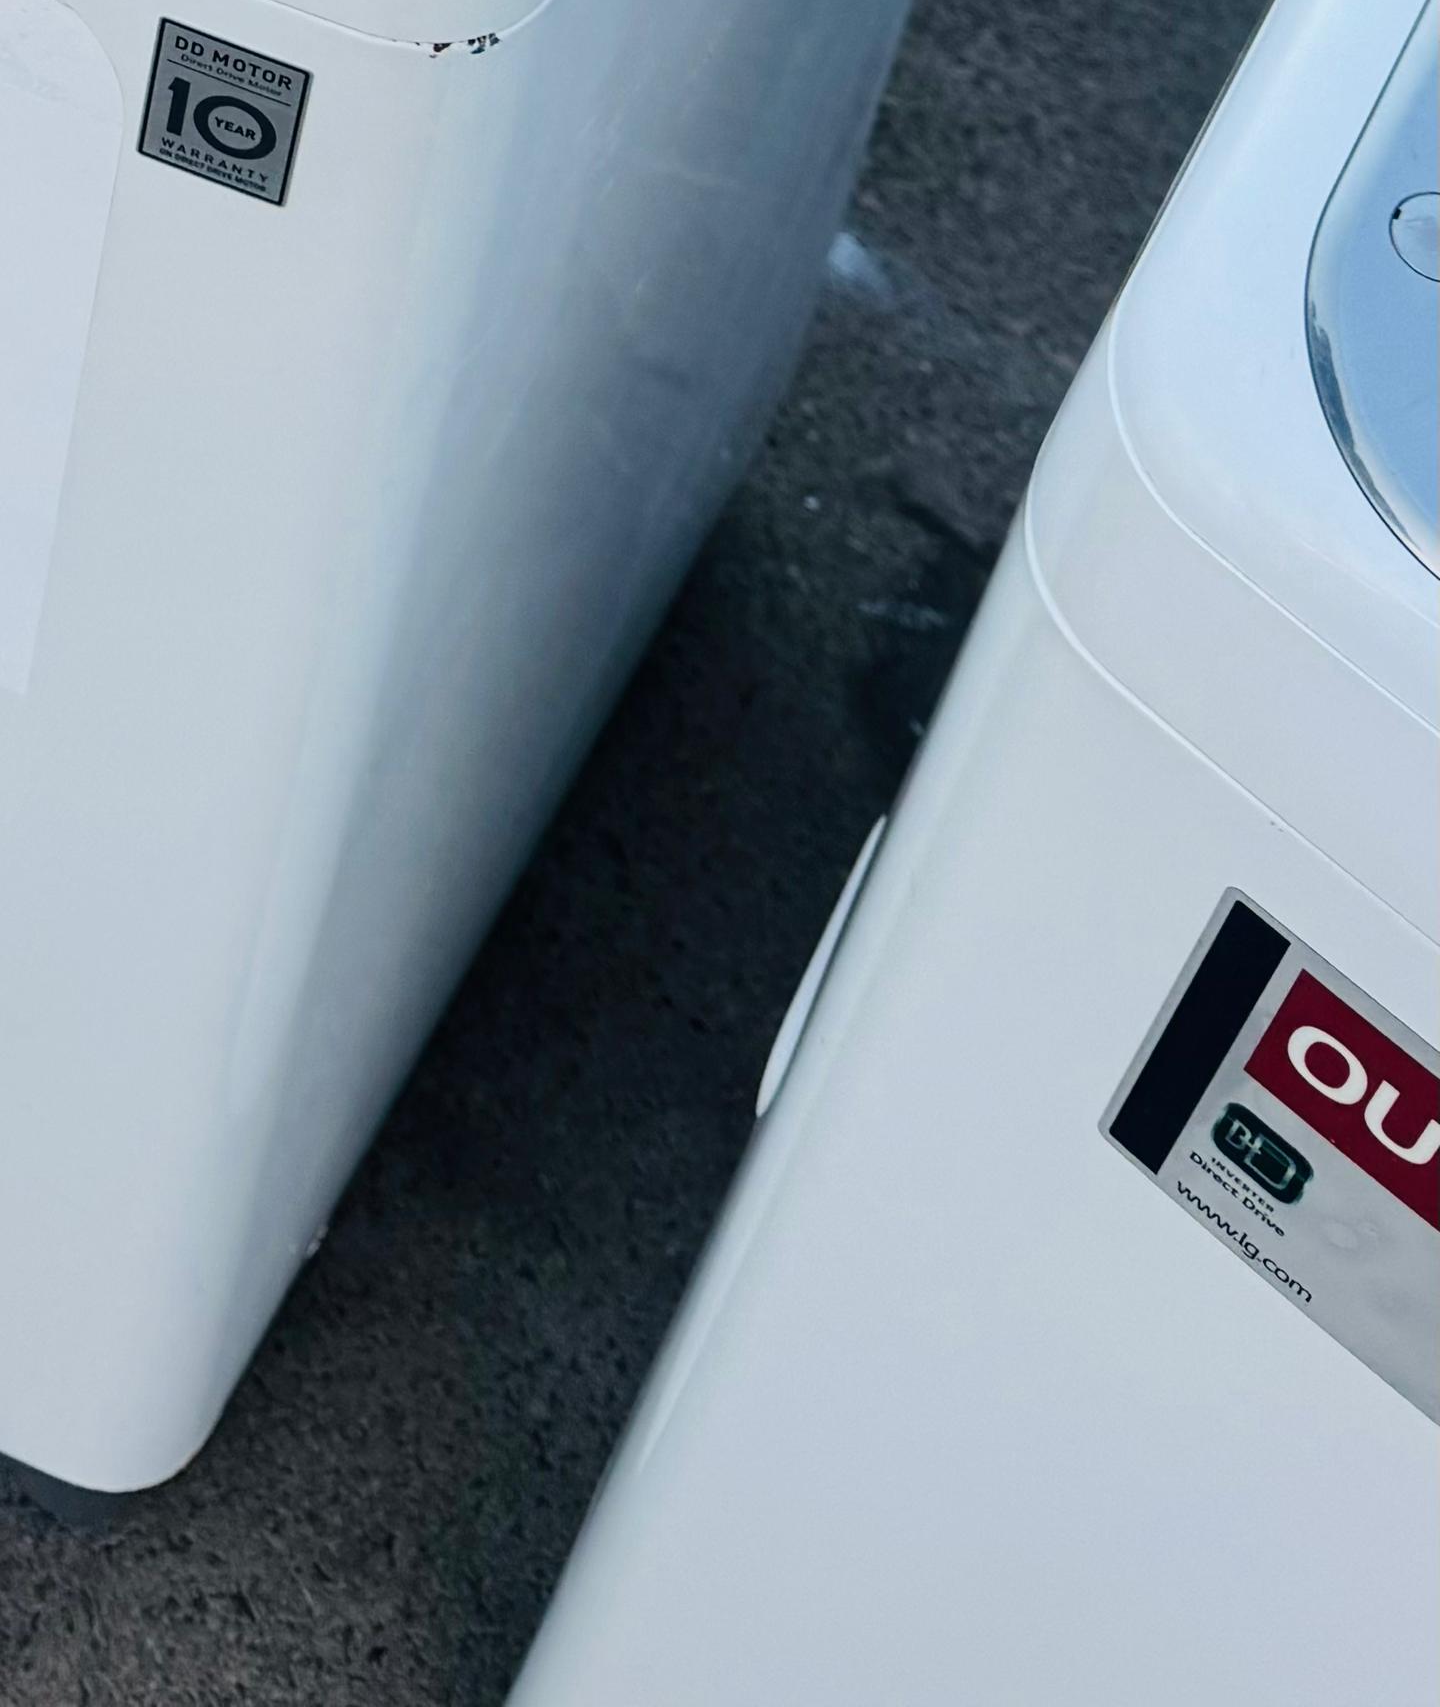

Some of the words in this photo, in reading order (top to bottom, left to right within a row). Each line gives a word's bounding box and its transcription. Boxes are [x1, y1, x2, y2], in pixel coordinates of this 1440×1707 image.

[175, 35, 204, 57] DD
[212, 50, 292, 91] MOTOR
[166, 76, 277, 160] 10
[215, 116, 257, 141] YEAR
[161, 137, 268, 183] WARRANTY
[1189, 1151, 1239, 1199] Direct
[1242, 1195, 1286, 1238] Drive
[1211, 1156, 1275, 1213] INVERTER
[1177, 1180, 1313, 1304] www.lg.com
